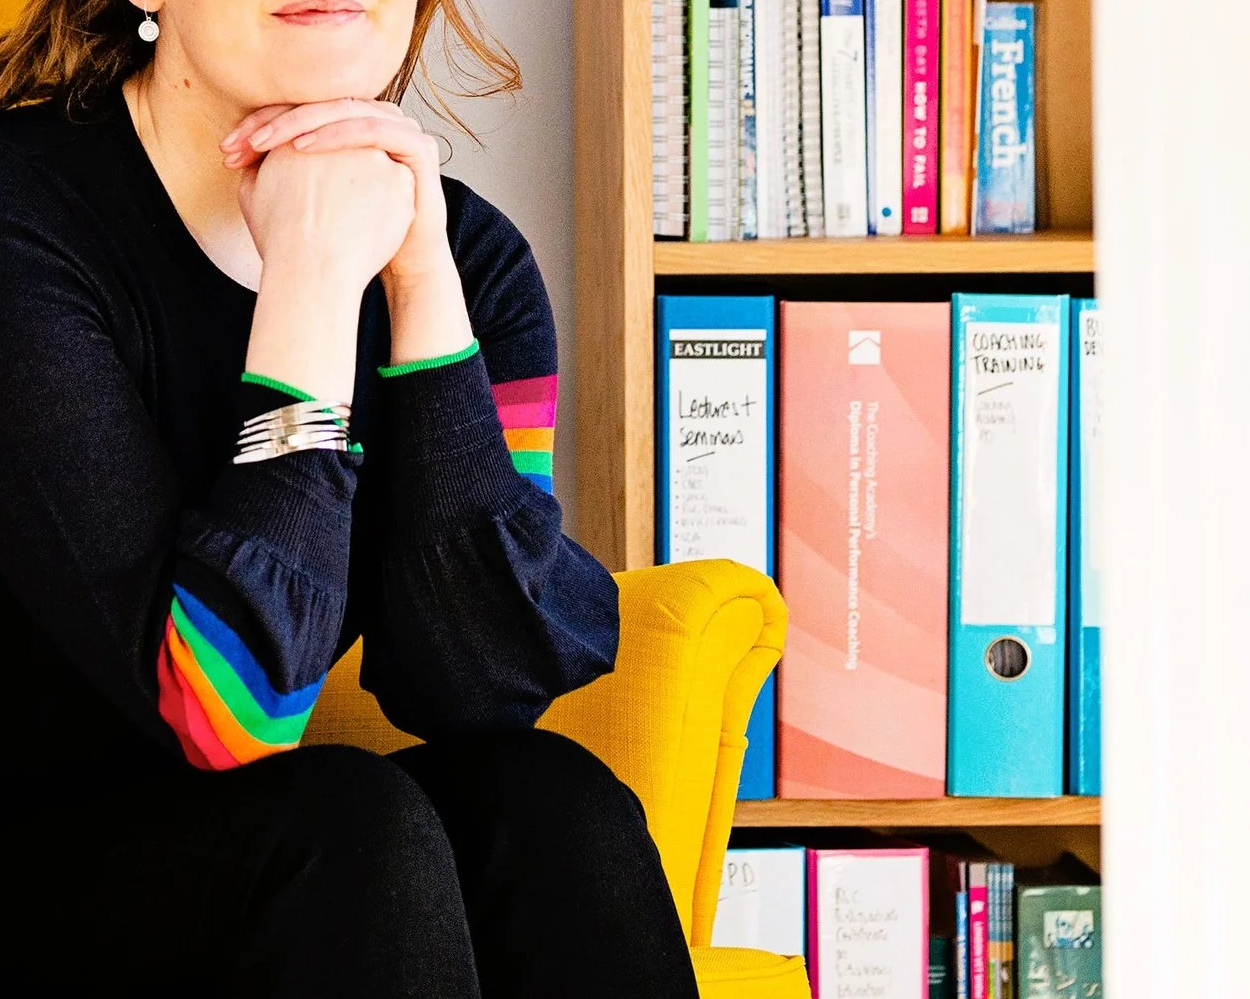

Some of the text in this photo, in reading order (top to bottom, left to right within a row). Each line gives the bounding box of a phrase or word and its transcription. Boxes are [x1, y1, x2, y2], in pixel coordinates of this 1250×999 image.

[914, 81, 927, 120] HOW
[991, 39, 1027, 168] French
[914, 126, 927, 149] TO
[912, 154, 926, 189] FAIL
[674, 342, 763, 358] EASTLIGHT
[973, 332, 1046, 351] COACHING
[971, 355, 1046, 376] TRAINING
[848, 401, 862, 455] Diploma
[862, 401, 879, 541] The Coaching Academy's
[849, 471, 862, 527] Personal
[848, 528, 861, 609] Performance
[845, 610, 860, 671] Coaching
[720, 861, 755, 887] PD
